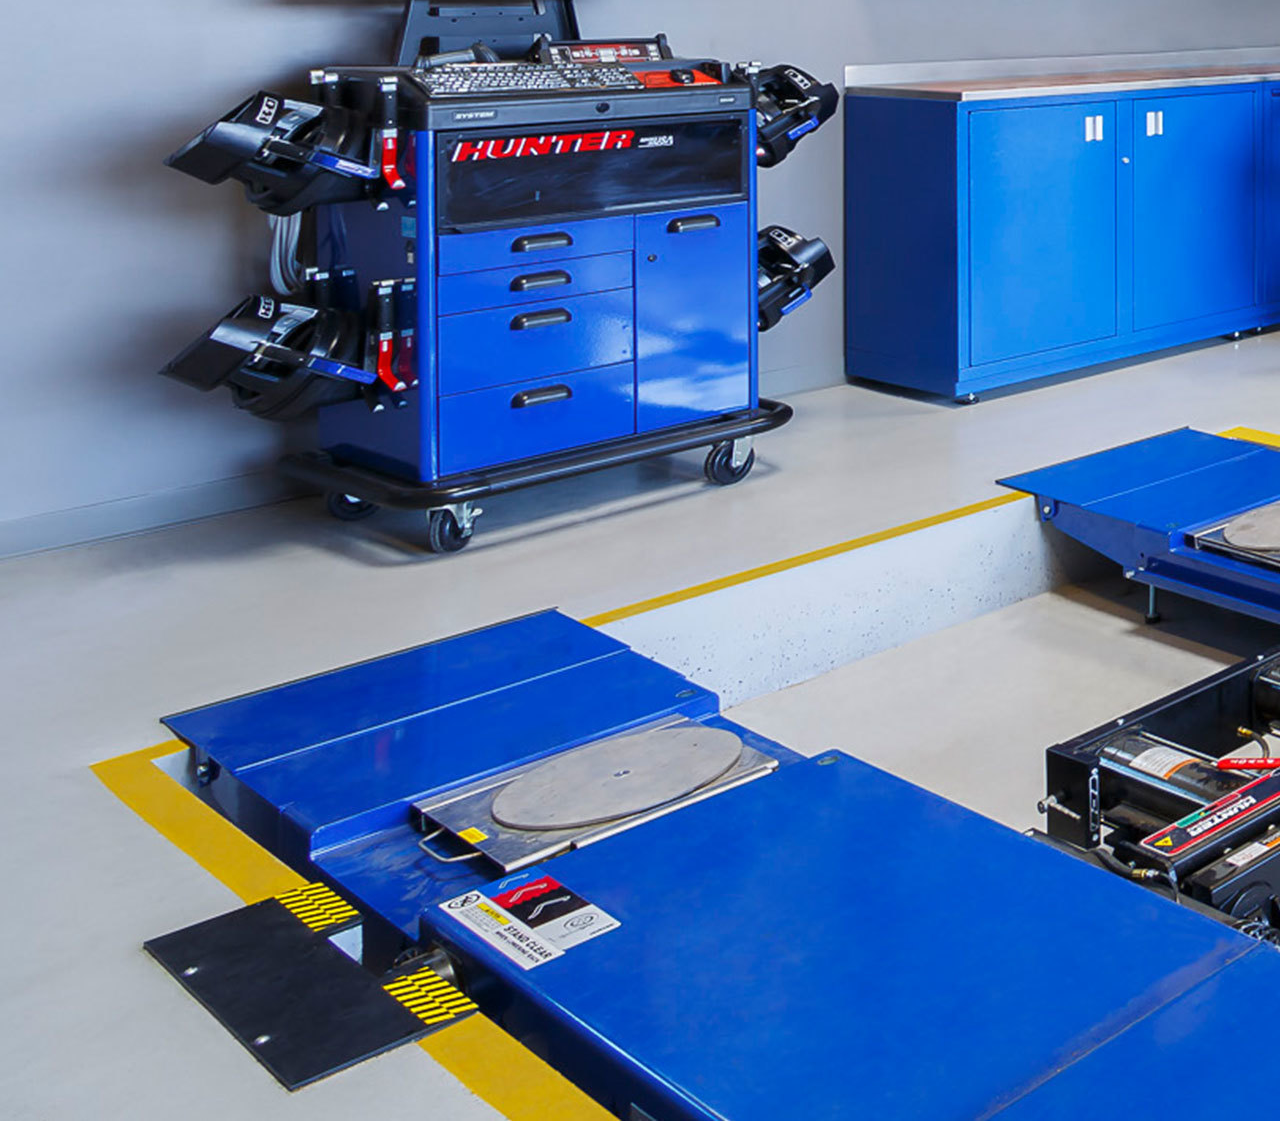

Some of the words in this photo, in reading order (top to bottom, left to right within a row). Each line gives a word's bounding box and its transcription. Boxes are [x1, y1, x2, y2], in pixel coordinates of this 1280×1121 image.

[455, 110, 495, 121] SYSTEM
[451, 130, 635, 162] HUNTER
[1186, 794, 1258, 838] HUNTER
[503, 924, 529, 944] STAND
[526, 940, 553, 960] CLEAR
